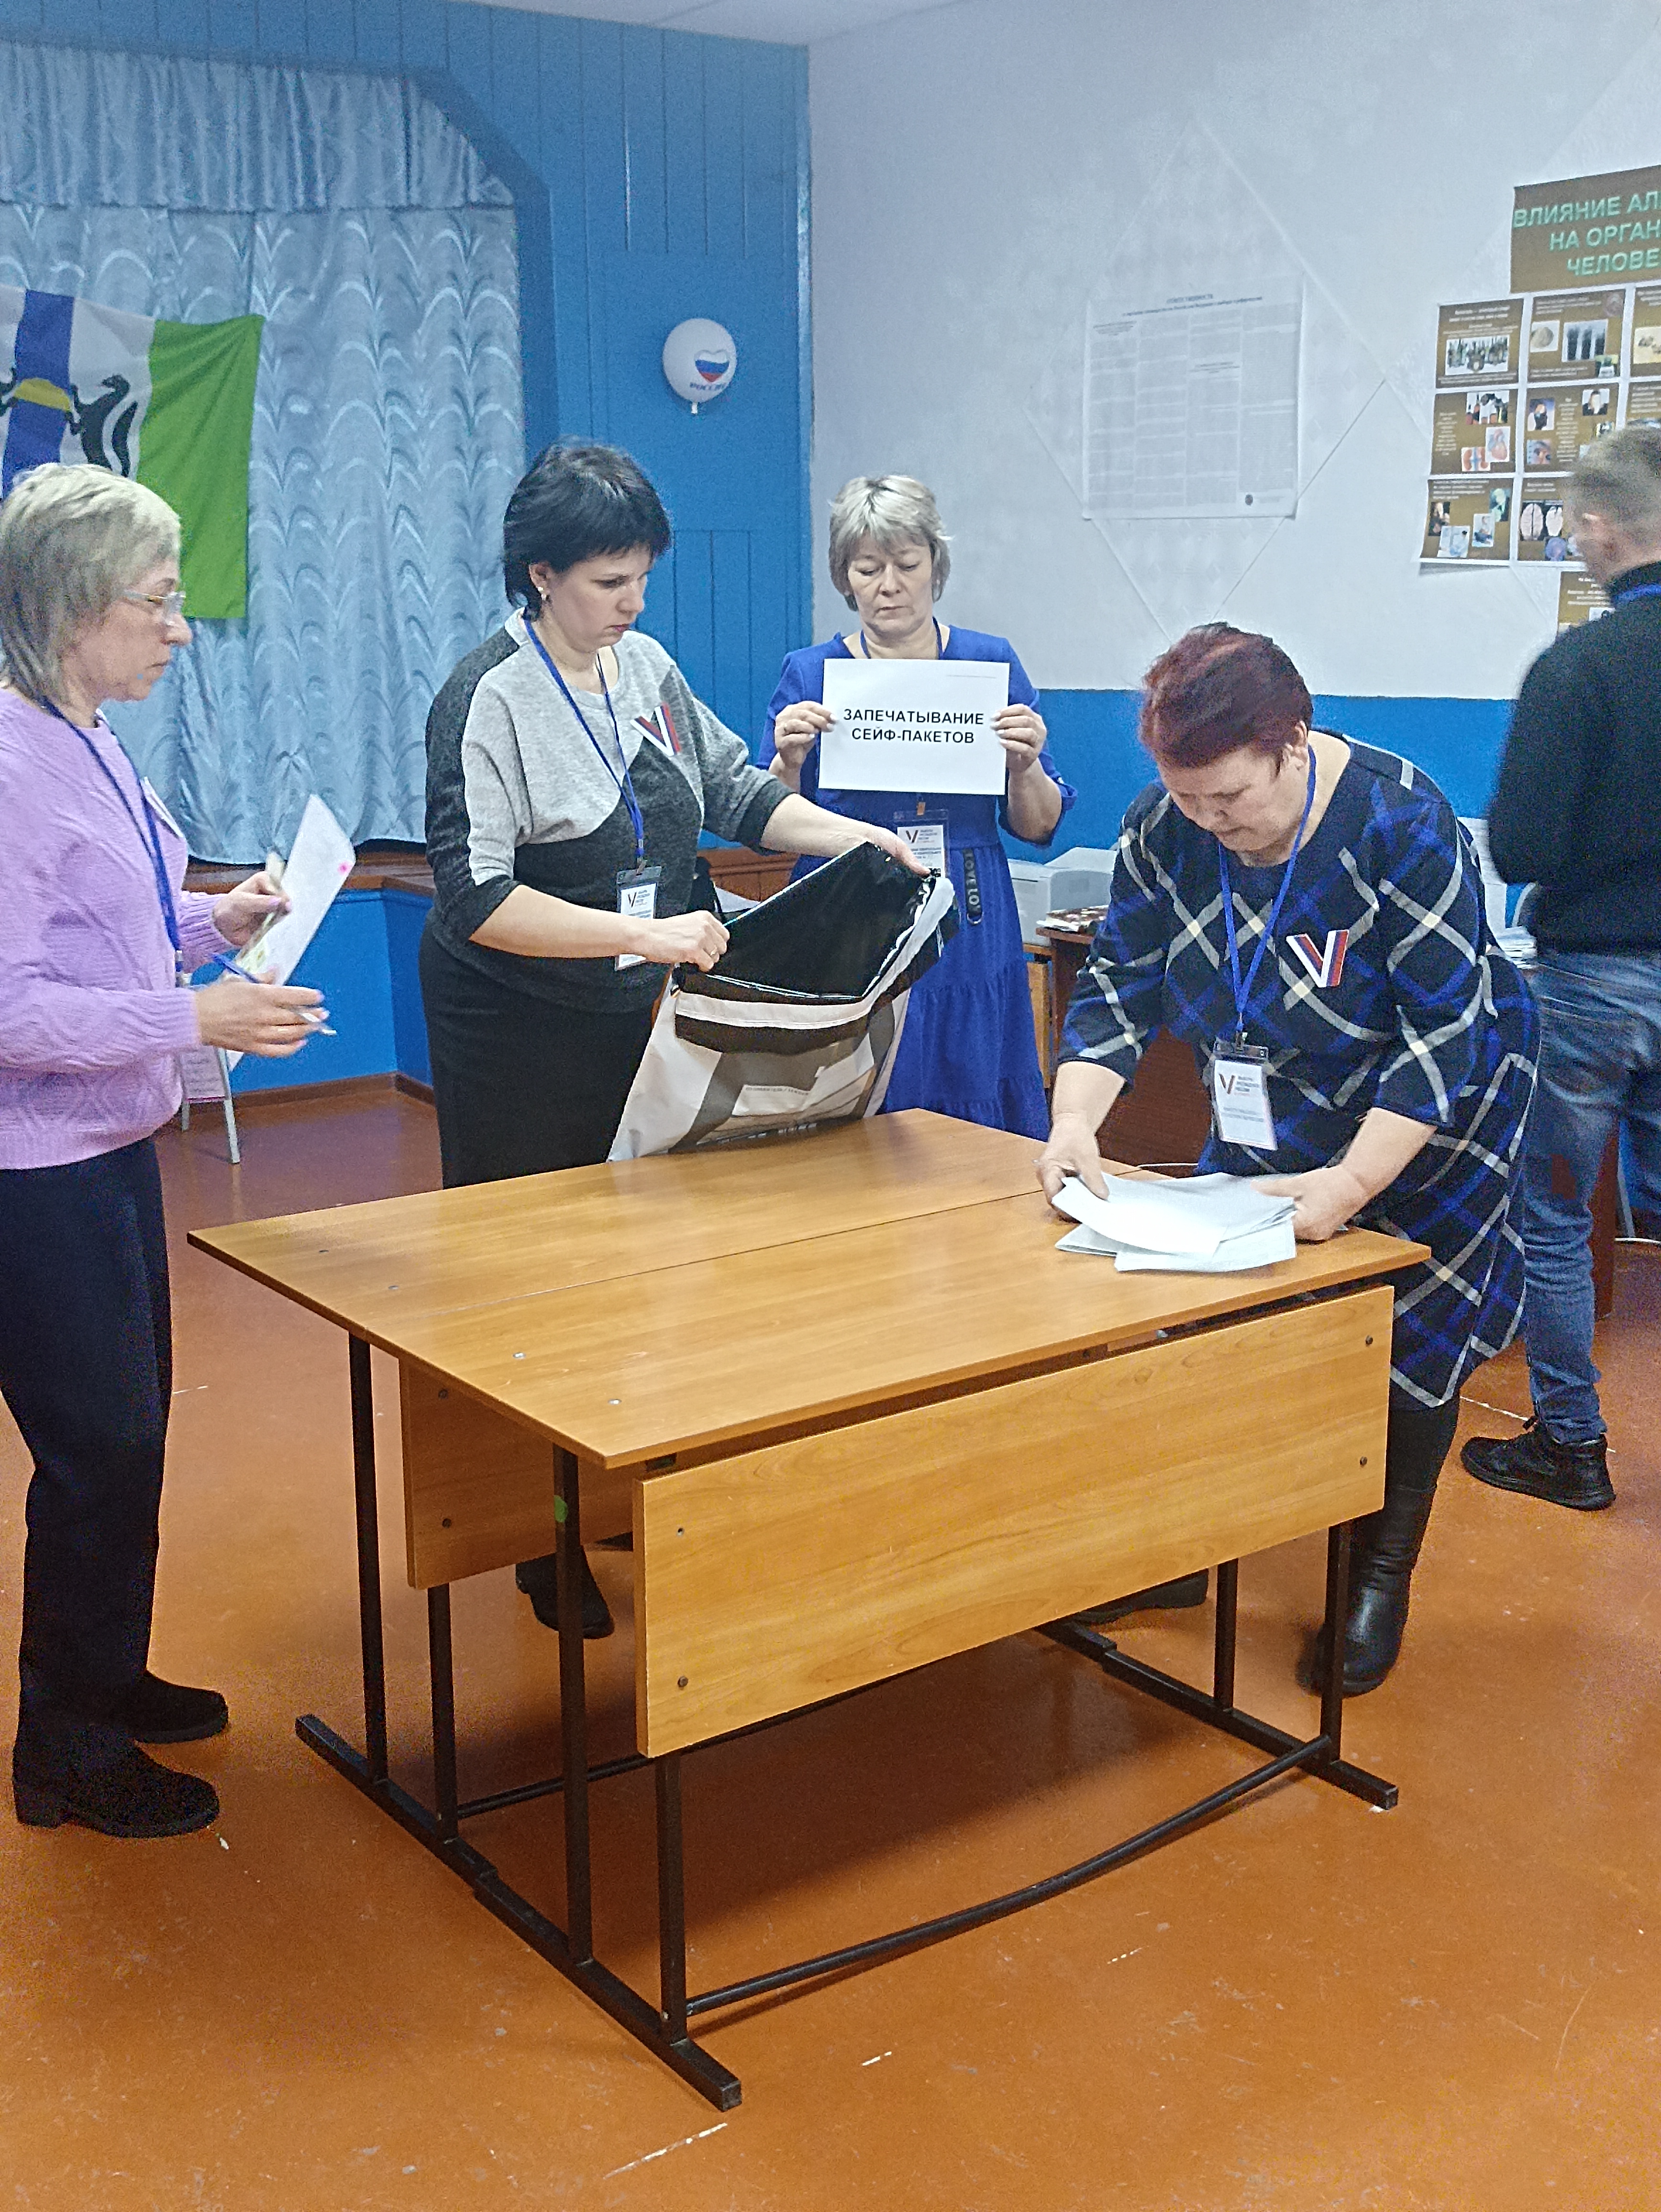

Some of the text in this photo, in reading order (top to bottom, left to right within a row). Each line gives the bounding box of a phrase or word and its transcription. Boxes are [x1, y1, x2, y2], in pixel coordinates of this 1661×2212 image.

[1513, 190, 1661, 228] ВЛИЯНИЕ АЛ
[1550, 219, 1661, 251] НА ОРГАН
[1567, 248, 1661, 276] ЧЕЛОВЕ
[843, 708, 984, 725] ЗАПЕЧАТЫВАНИЕ
[852, 726, 974, 743] СЕЙФ-ПАКЕТОВ
